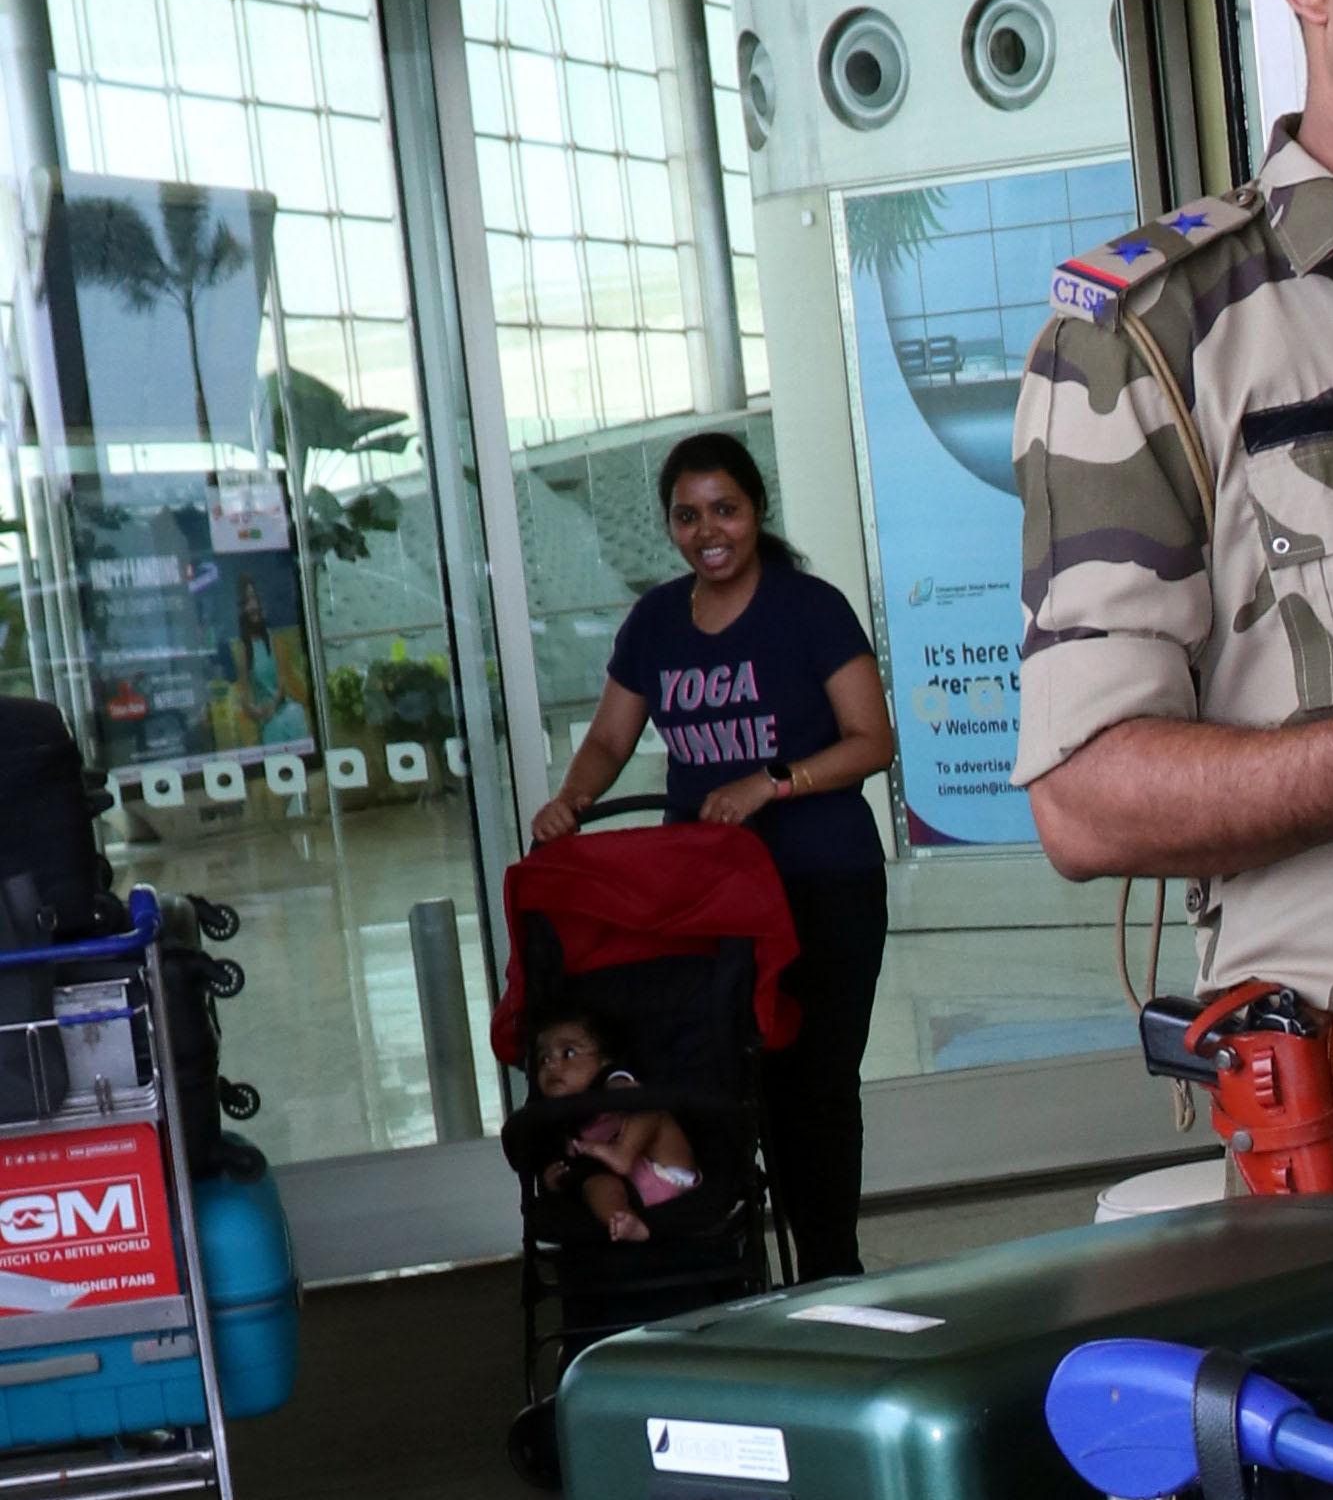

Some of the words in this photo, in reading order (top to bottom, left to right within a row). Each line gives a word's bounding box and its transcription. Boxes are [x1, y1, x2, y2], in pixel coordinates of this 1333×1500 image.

[924, 643, 956, 668] It's
[962, 641, 1008, 665] here
[660, 660, 758, 712] YOGA
[660, 714, 778, 765] UNKIE
[946, 718, 1008, 736] Welcome
[936, 761, 950, 774] To
[954, 758, 1011, 773] advertise
[0, 1183, 137, 1244] GM
[34, 1250, 50, 1263] TO
[53, 1249, 62, 1261] A
[64, 1244, 104, 1260] BETTER
[106, 1238, 150, 1253] WORLD
[50, 1277, 118, 1297] DESIGNER
[121, 1272, 156, 1288] FANS
